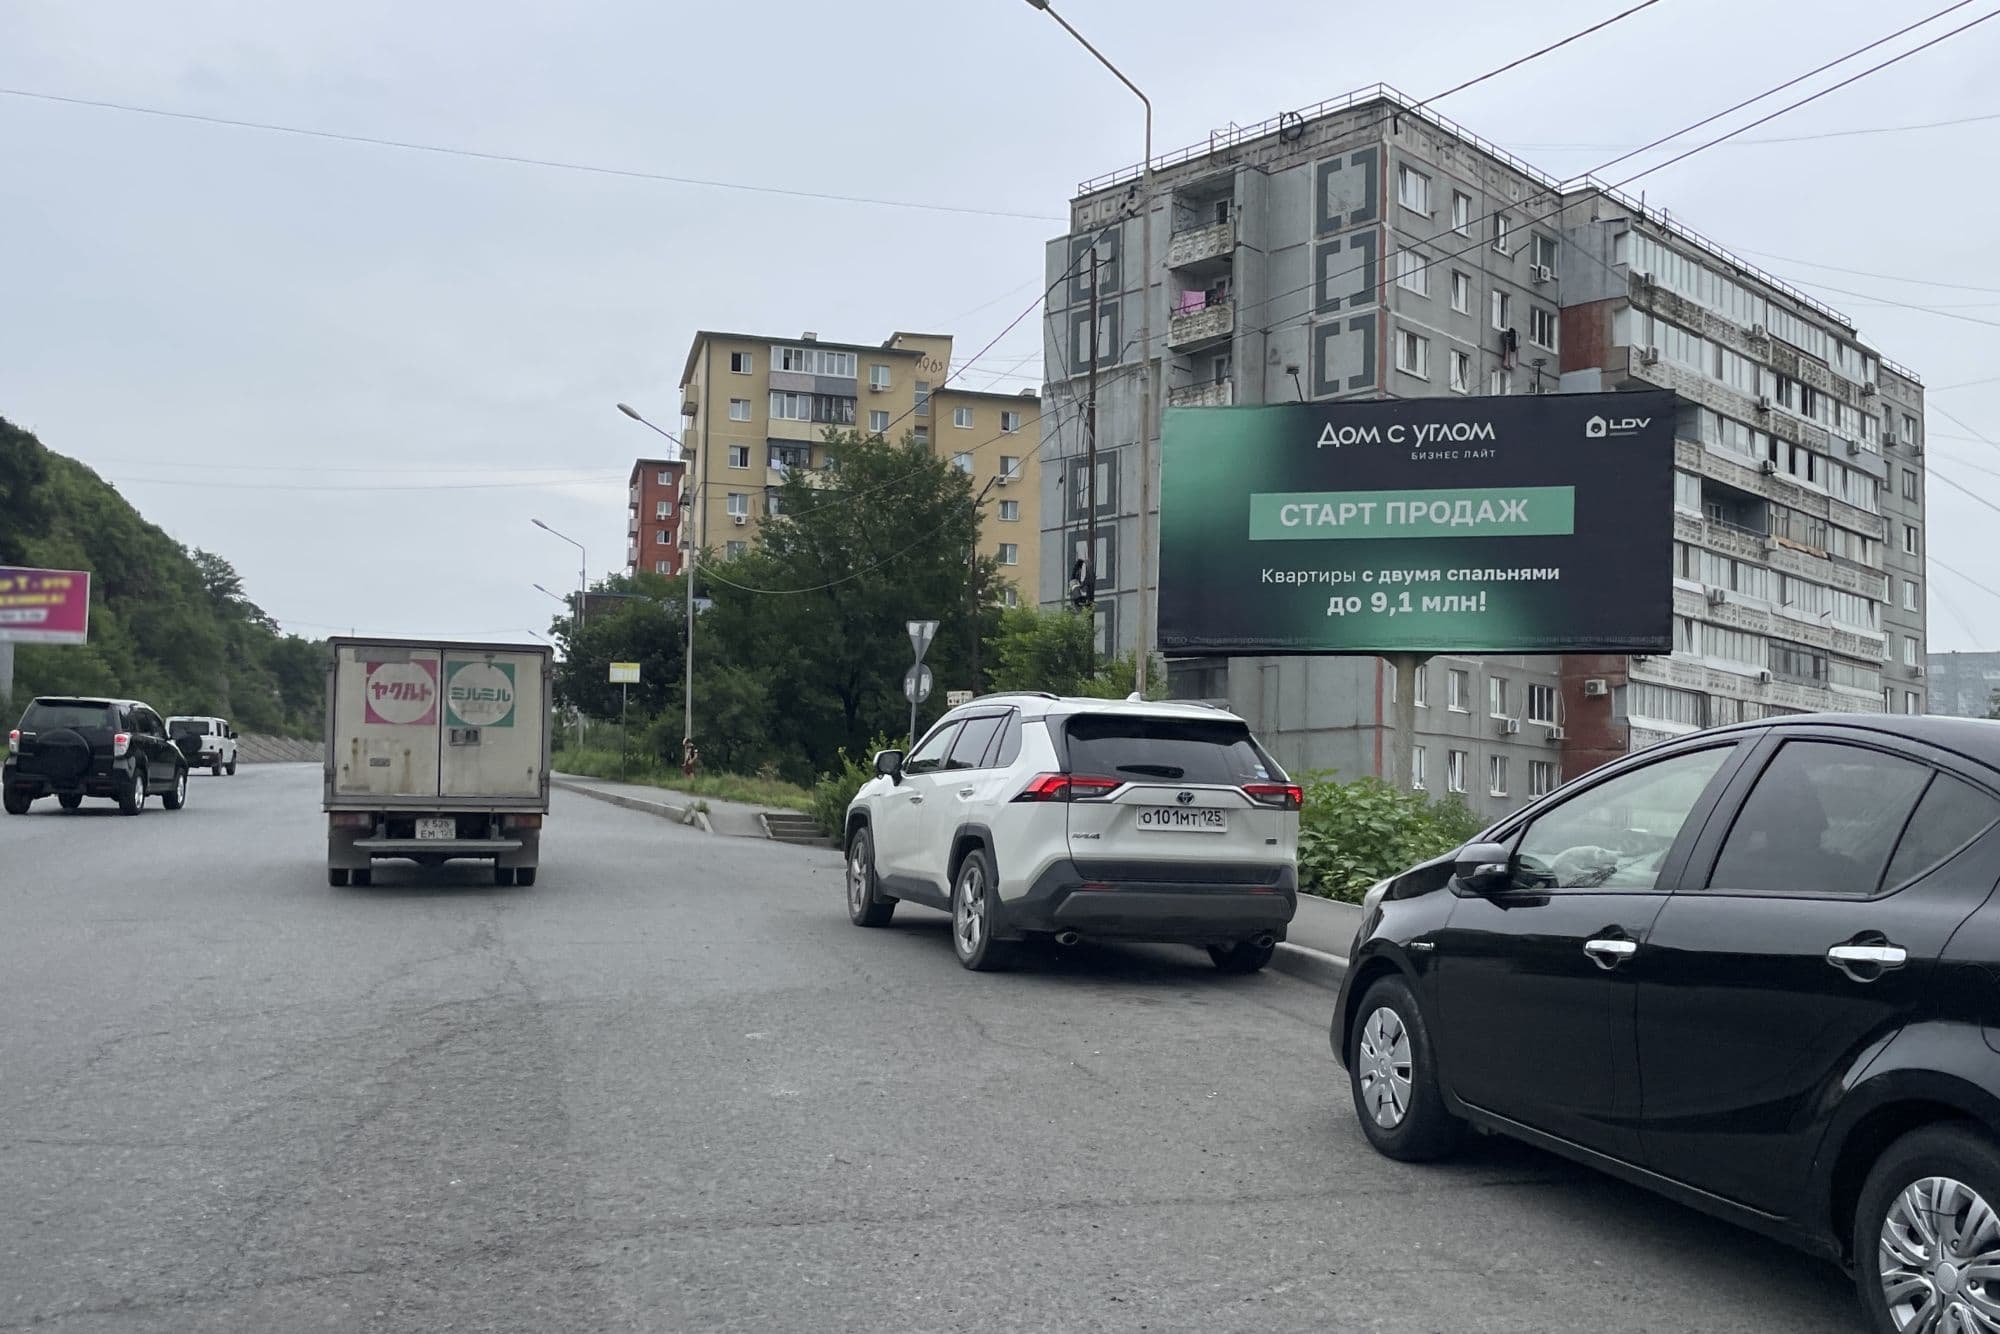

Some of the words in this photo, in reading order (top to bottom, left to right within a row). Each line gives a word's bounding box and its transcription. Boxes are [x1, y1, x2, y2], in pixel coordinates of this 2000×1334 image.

[1609, 418, 1651, 429] LDV
[1411, 450, 1459, 461] БИЗНЕС
[1463, 448, 1496, 460] ЛАЙТ
[1280, 502, 1377, 527] СТАРТ
[1385, 499, 1529, 526] ПРОДАЖ
[1261, 567, 1357, 586] Квартиры
[1362, 570, 1374, 583] с
[1378, 569, 1442, 585] двумя
[1446, 567, 1560, 583] спальнями
[1326, 596, 1362, 616] до
[1370, 591, 1413, 616] 9,1
[1421, 590, 1486, 613] млн!
[371, 681, 433, 701] ヤクルト
[450, 686, 512, 703] ミルミル
[1200, 810, 1221, 822] 125
